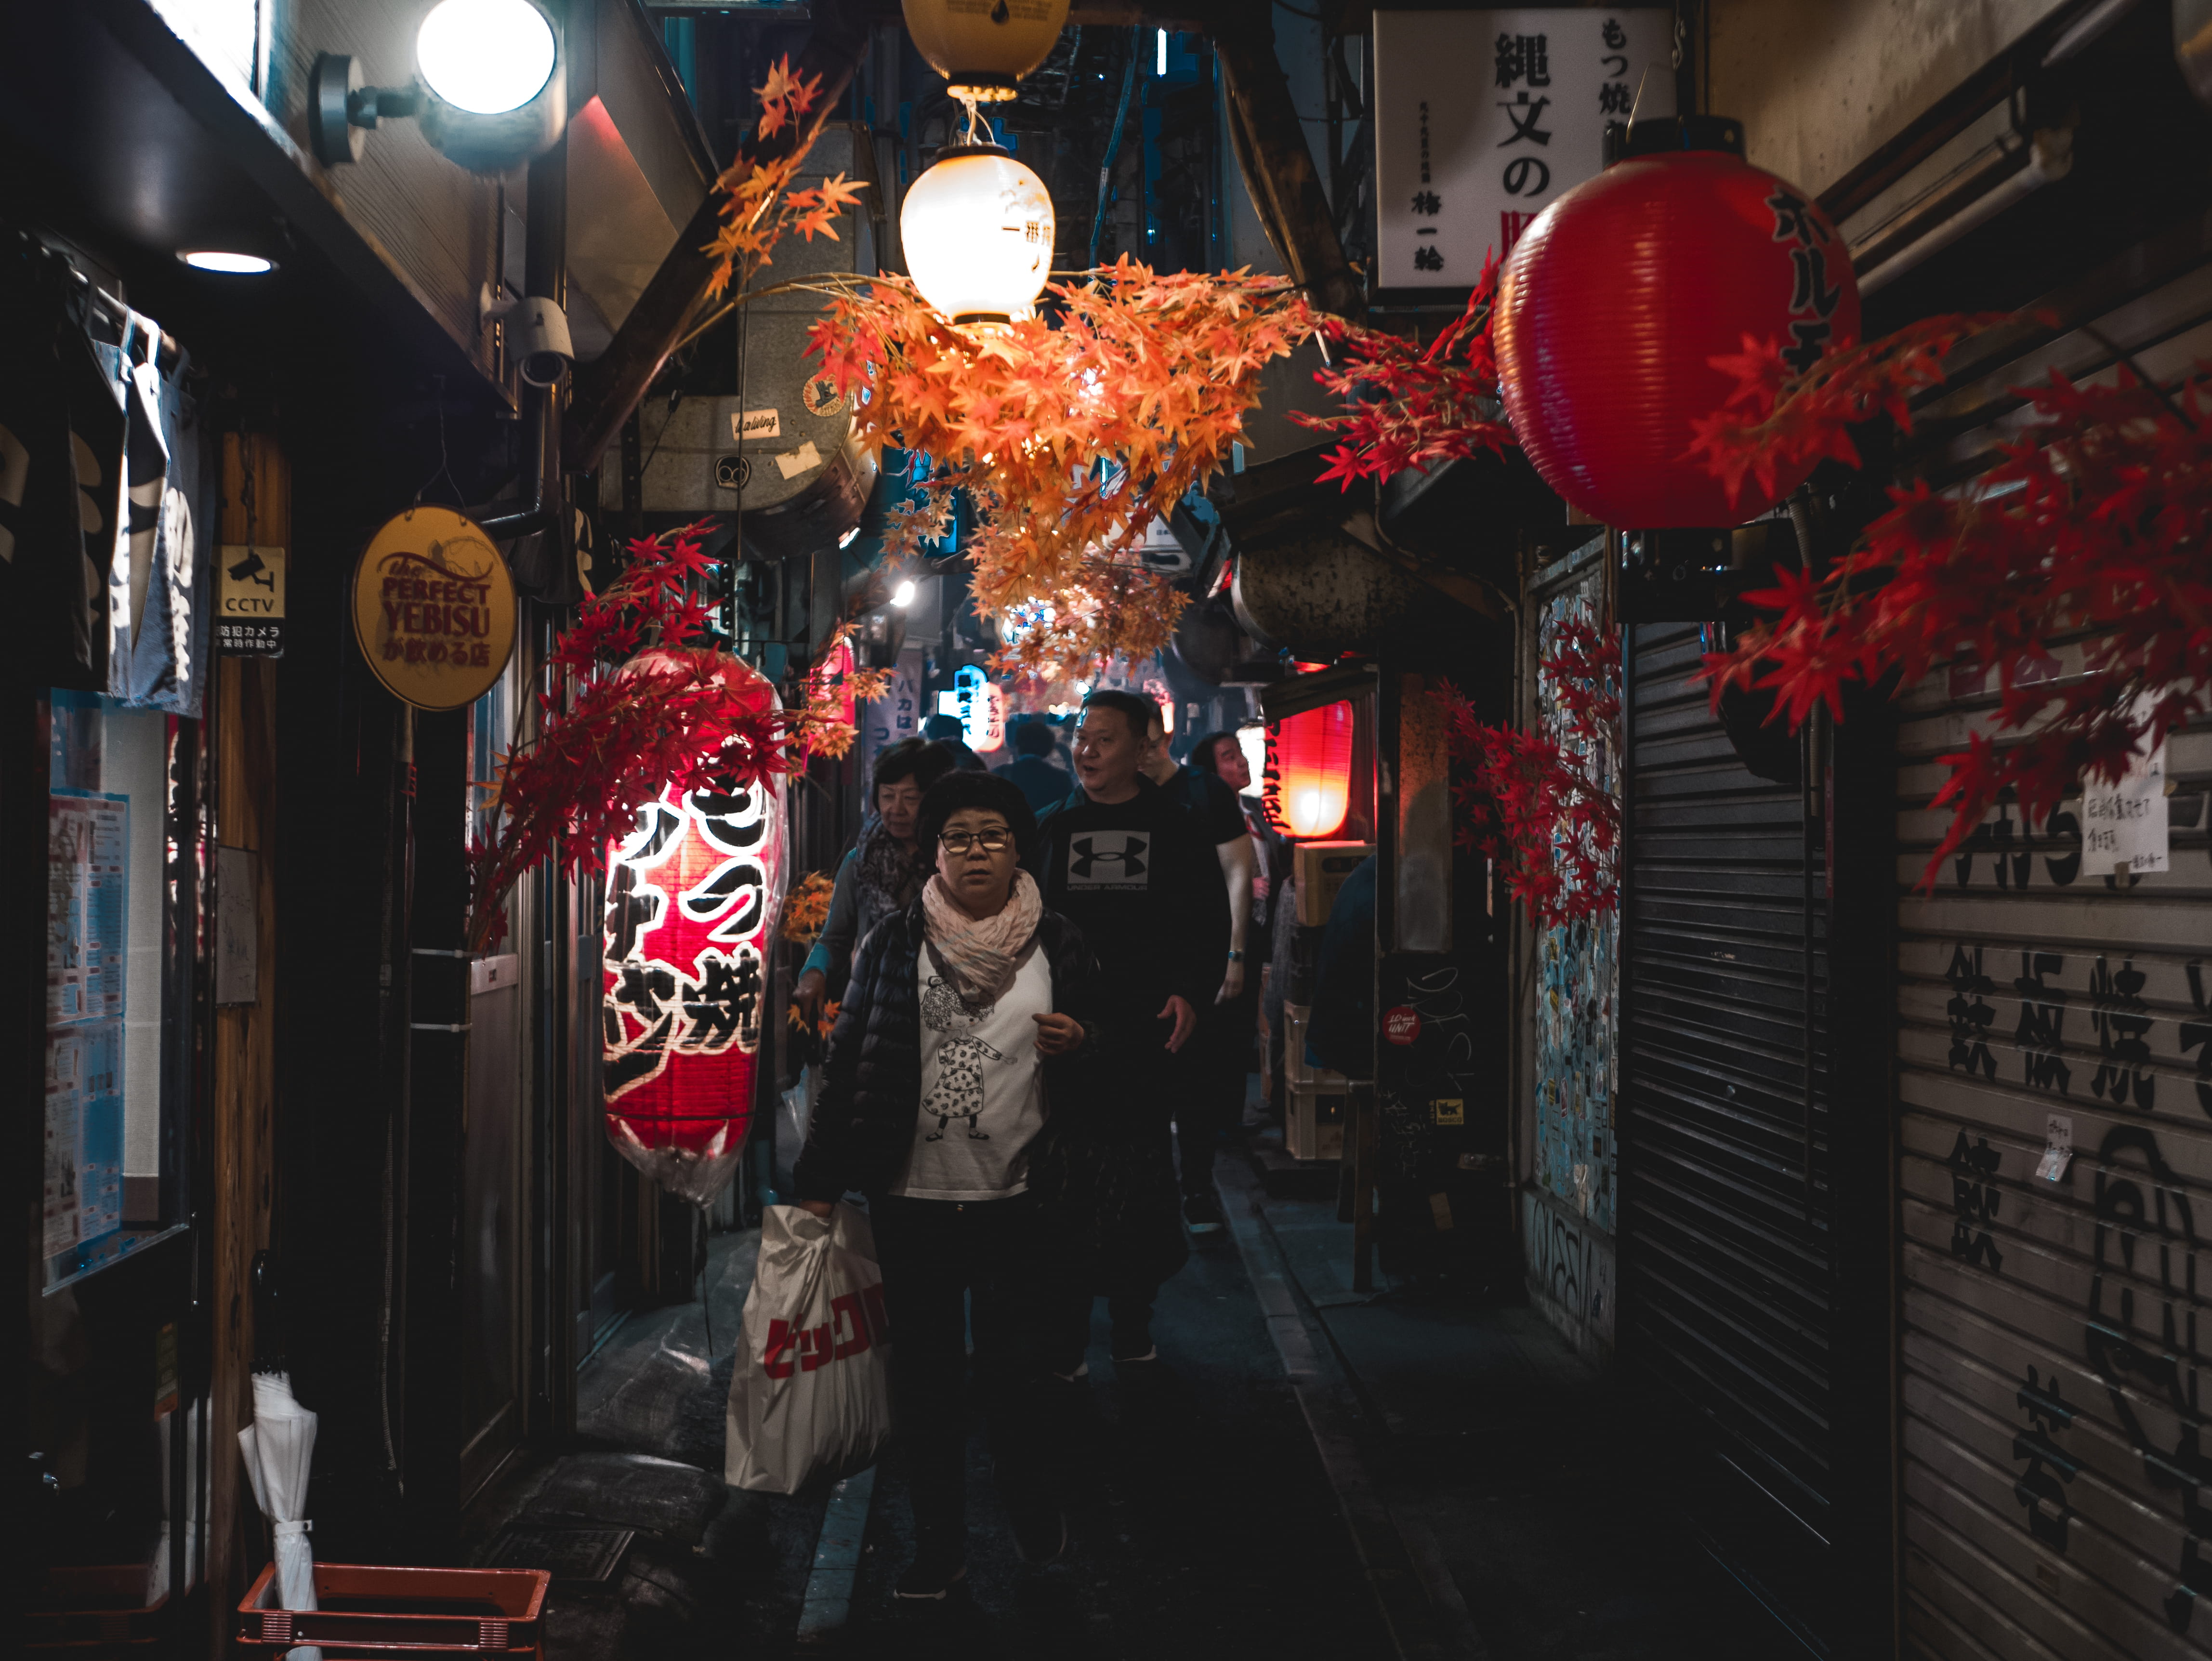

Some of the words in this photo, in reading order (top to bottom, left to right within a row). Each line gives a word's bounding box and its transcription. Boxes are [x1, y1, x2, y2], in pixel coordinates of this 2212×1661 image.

[383, 578, 491, 604] PERFECT
[226, 598, 274, 612] CCTV
[383, 601, 489, 637] YEBISU
[220, 626, 280, 637] 防犯カメラ
[223, 638, 276, 649] 常時作動中
[382, 638, 490, 667] が飲める店
